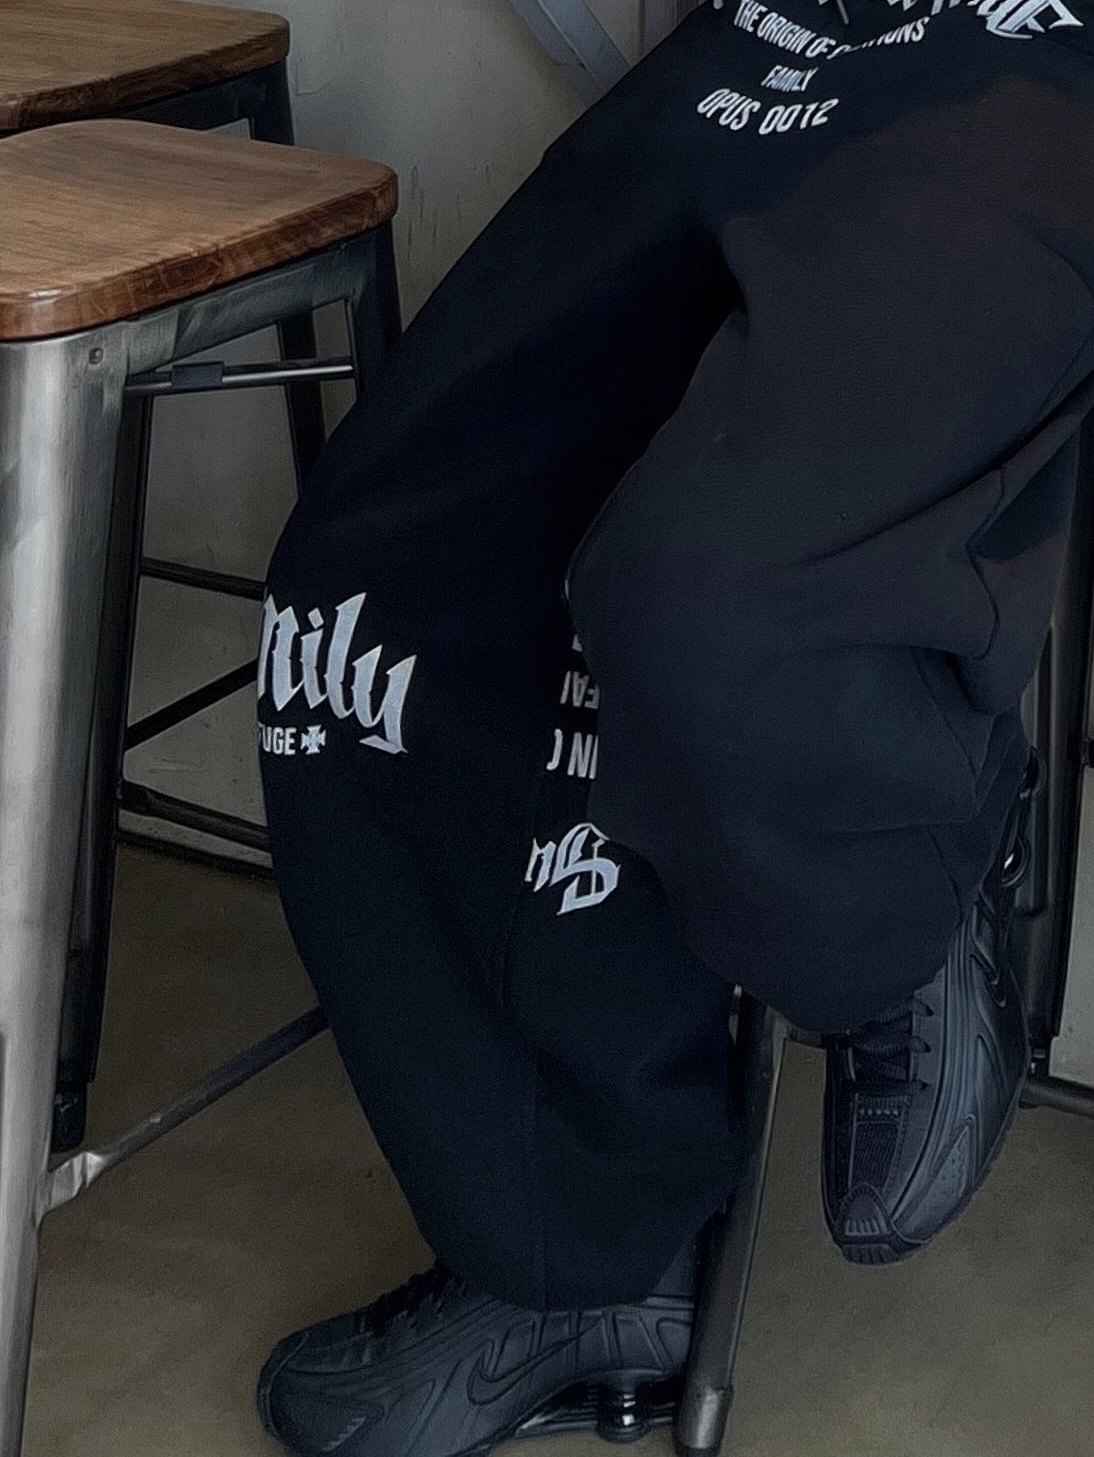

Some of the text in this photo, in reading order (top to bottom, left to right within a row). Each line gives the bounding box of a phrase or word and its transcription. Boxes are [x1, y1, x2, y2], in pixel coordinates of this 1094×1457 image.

[756, 11, 818, 54] ORIGIN
[804, 36, 837, 58] OF
[697, 88, 839, 135] OPUS 0012
